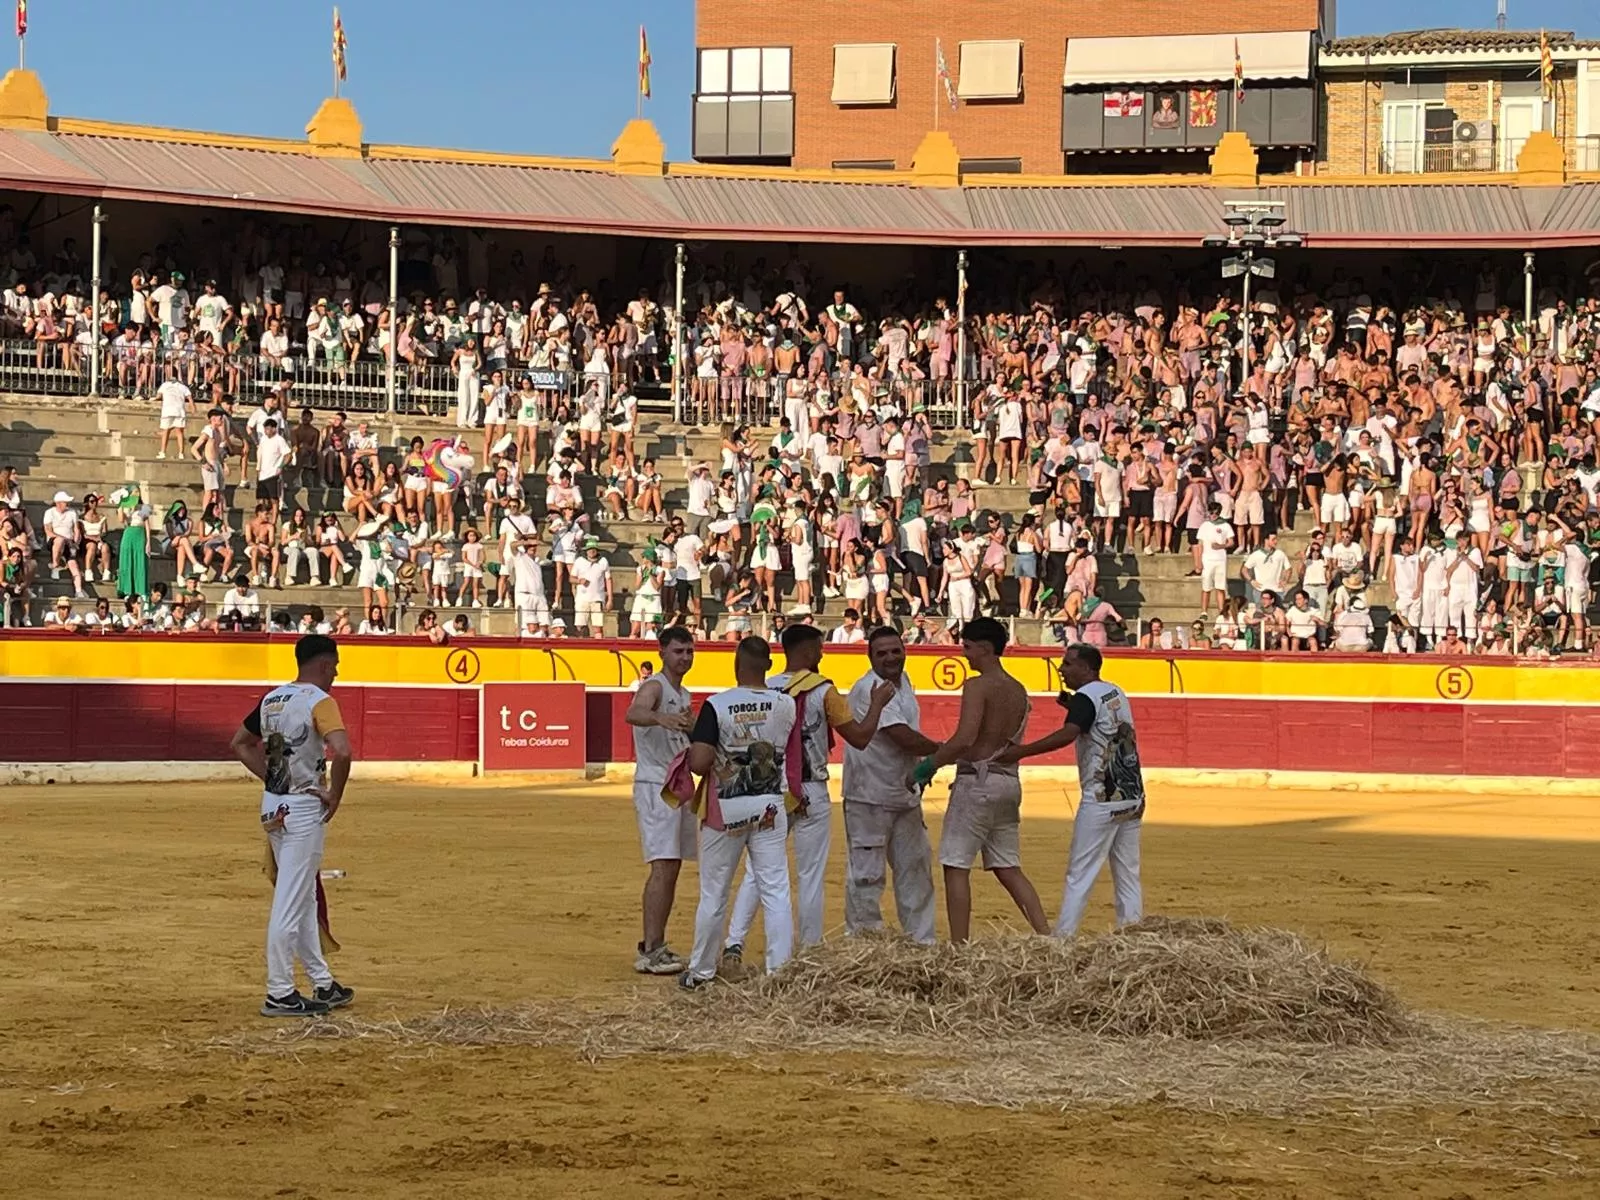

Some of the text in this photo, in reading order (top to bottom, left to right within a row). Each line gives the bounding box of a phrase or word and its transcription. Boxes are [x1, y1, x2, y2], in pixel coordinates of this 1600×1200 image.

[455, 654, 468, 676] 4
[943, 664, 956, 685] 5
[1448, 672, 1462, 695] 5
[728, 702, 772, 715] TOROS EN
[500, 738, 527, 747] Tebas
